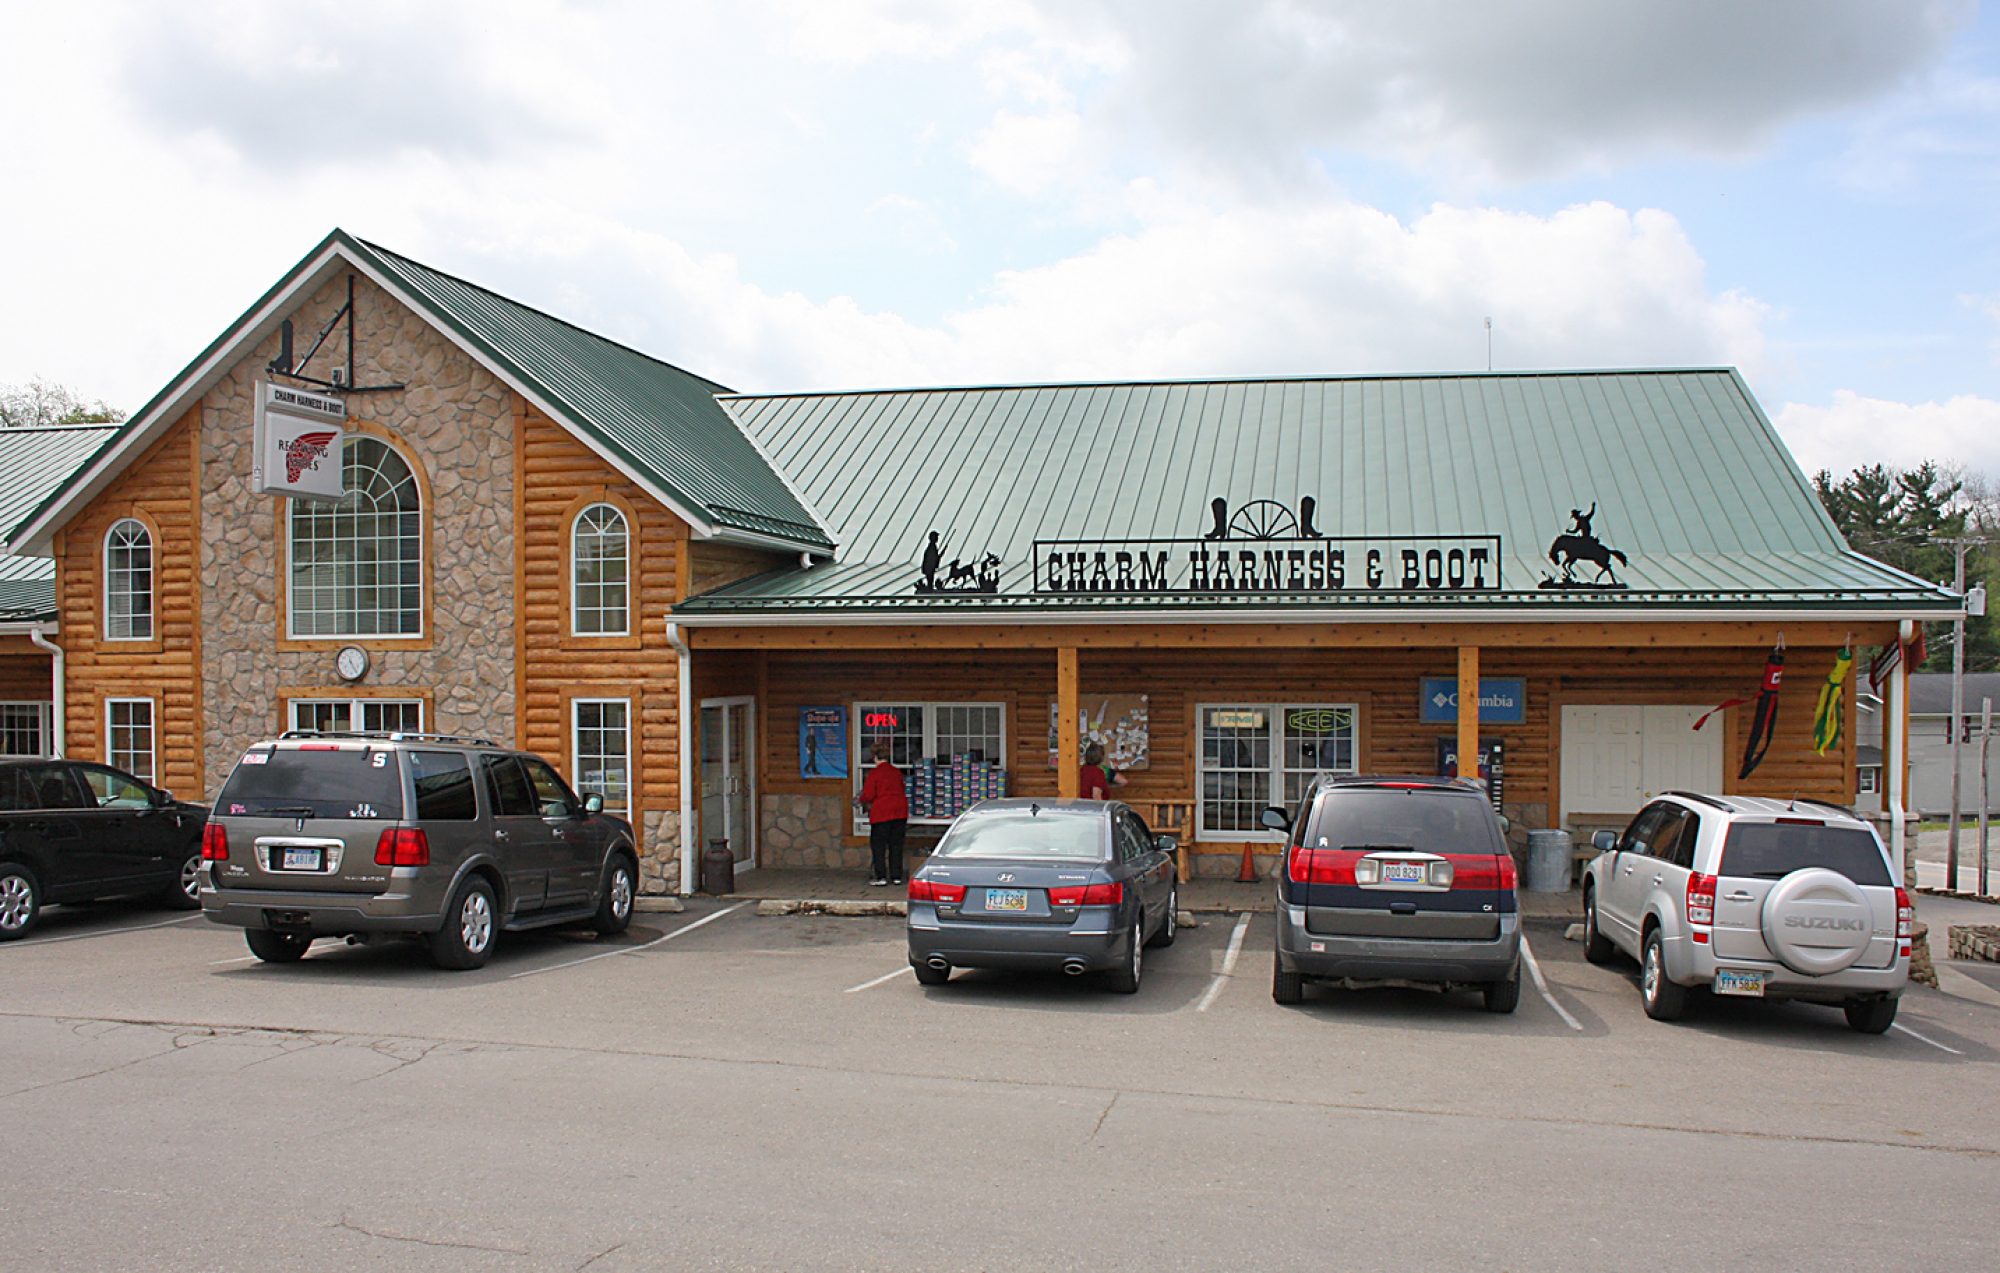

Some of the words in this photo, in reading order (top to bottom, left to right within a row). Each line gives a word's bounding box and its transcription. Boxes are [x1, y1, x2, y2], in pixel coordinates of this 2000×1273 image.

[274, 390, 296, 404] CHARM
[297, 394, 322, 410] HARNESS
[329, 402, 343, 414] BOOT
[1048, 551, 1168, 591] CHARM
[1190, 550, 1345, 590] HARNESS
[1367, 548, 1384, 589] &
[1401, 548, 1489, 589] BOOT
[865, 713, 898, 727] OPEN
[1290, 714, 1351, 728] KEEN
[372, 752, 388, 768] S
[1445, 754, 1490, 765] PSI
[1784, 915, 1865, 932] SUZUKI
